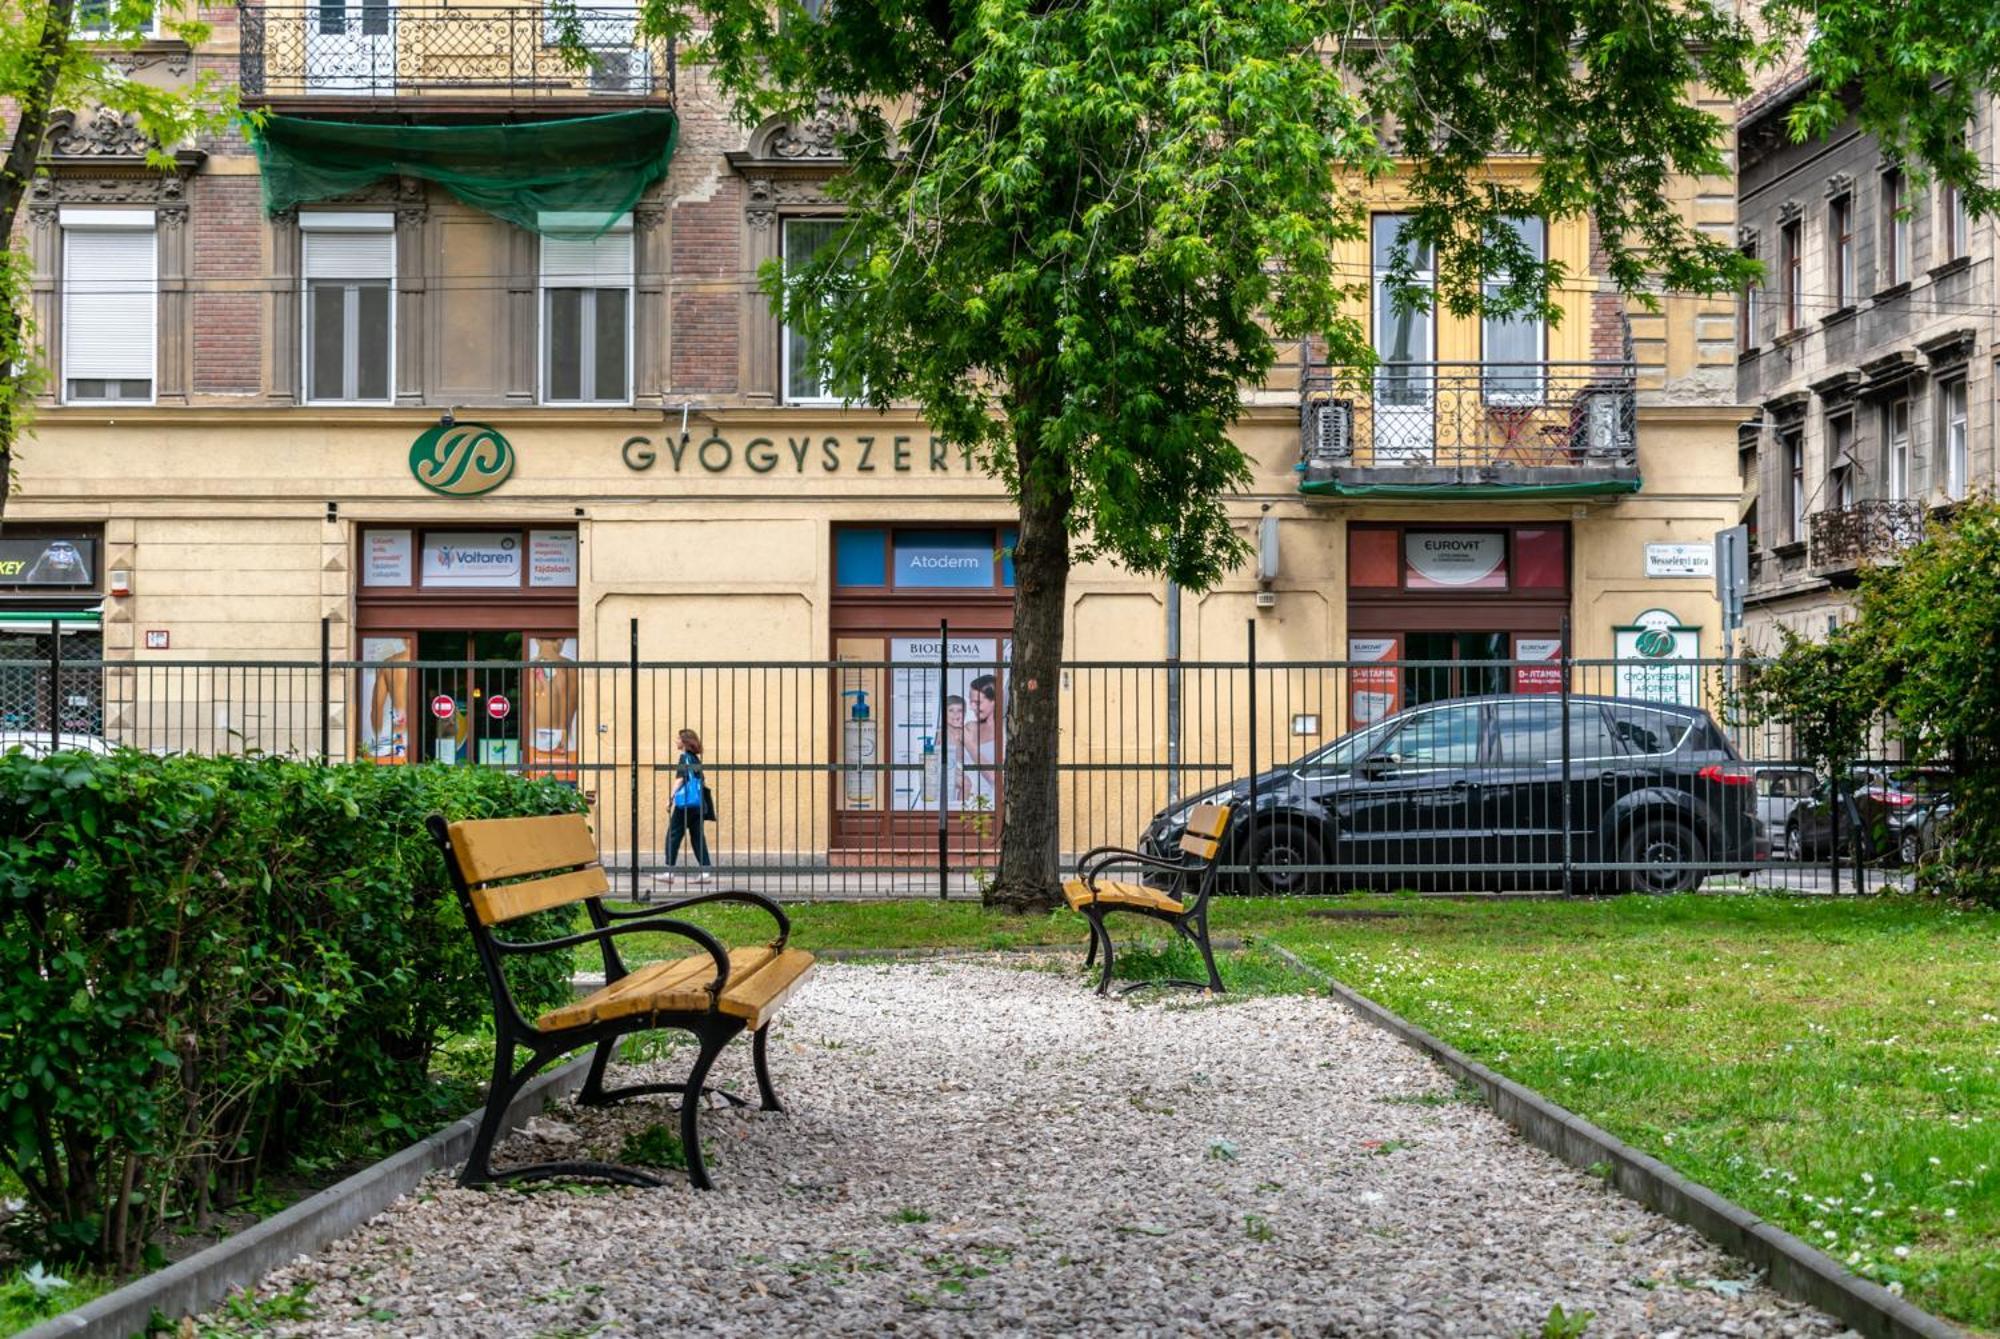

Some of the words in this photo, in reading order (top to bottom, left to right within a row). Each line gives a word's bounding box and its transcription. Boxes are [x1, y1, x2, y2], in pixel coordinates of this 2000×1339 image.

[456, 551, 513, 563] Voltaren
[910, 555, 979, 568] Atoderm
[910, 643, 980, 654] BIODRMA
